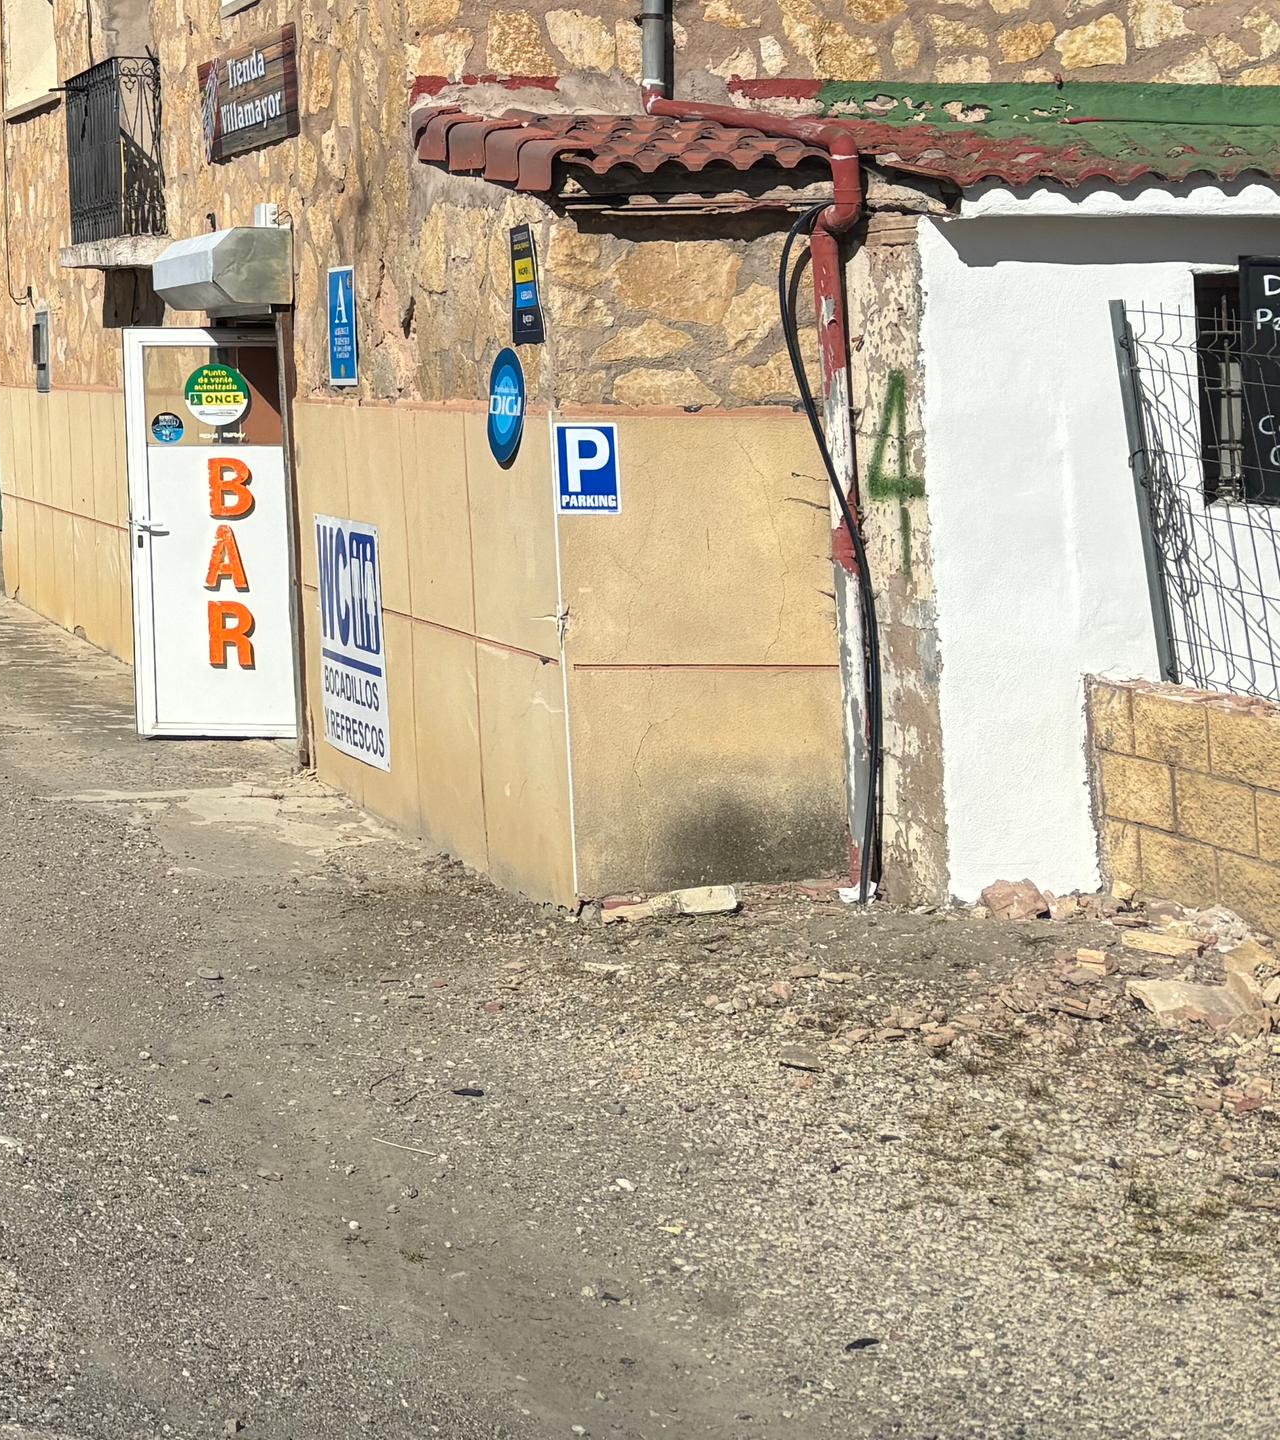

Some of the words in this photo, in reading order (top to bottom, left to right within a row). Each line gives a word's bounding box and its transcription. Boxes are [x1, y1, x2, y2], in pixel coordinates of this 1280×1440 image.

[227, 48, 265, 89] Tienda
[334, 275, 348, 323] A
[203, 369, 227, 377] Punto
[205, 394, 241, 403] ONCE
[490, 395, 521, 416] DIGI
[565, 428, 610, 492] P
[561, 494, 617, 507] PARKING
[205, 457, 255, 669] BAR
[316, 523, 349, 647] WC
[324, 665, 380, 712] BOCADILLOS
[330, 710, 385, 758] REFRESCOS
